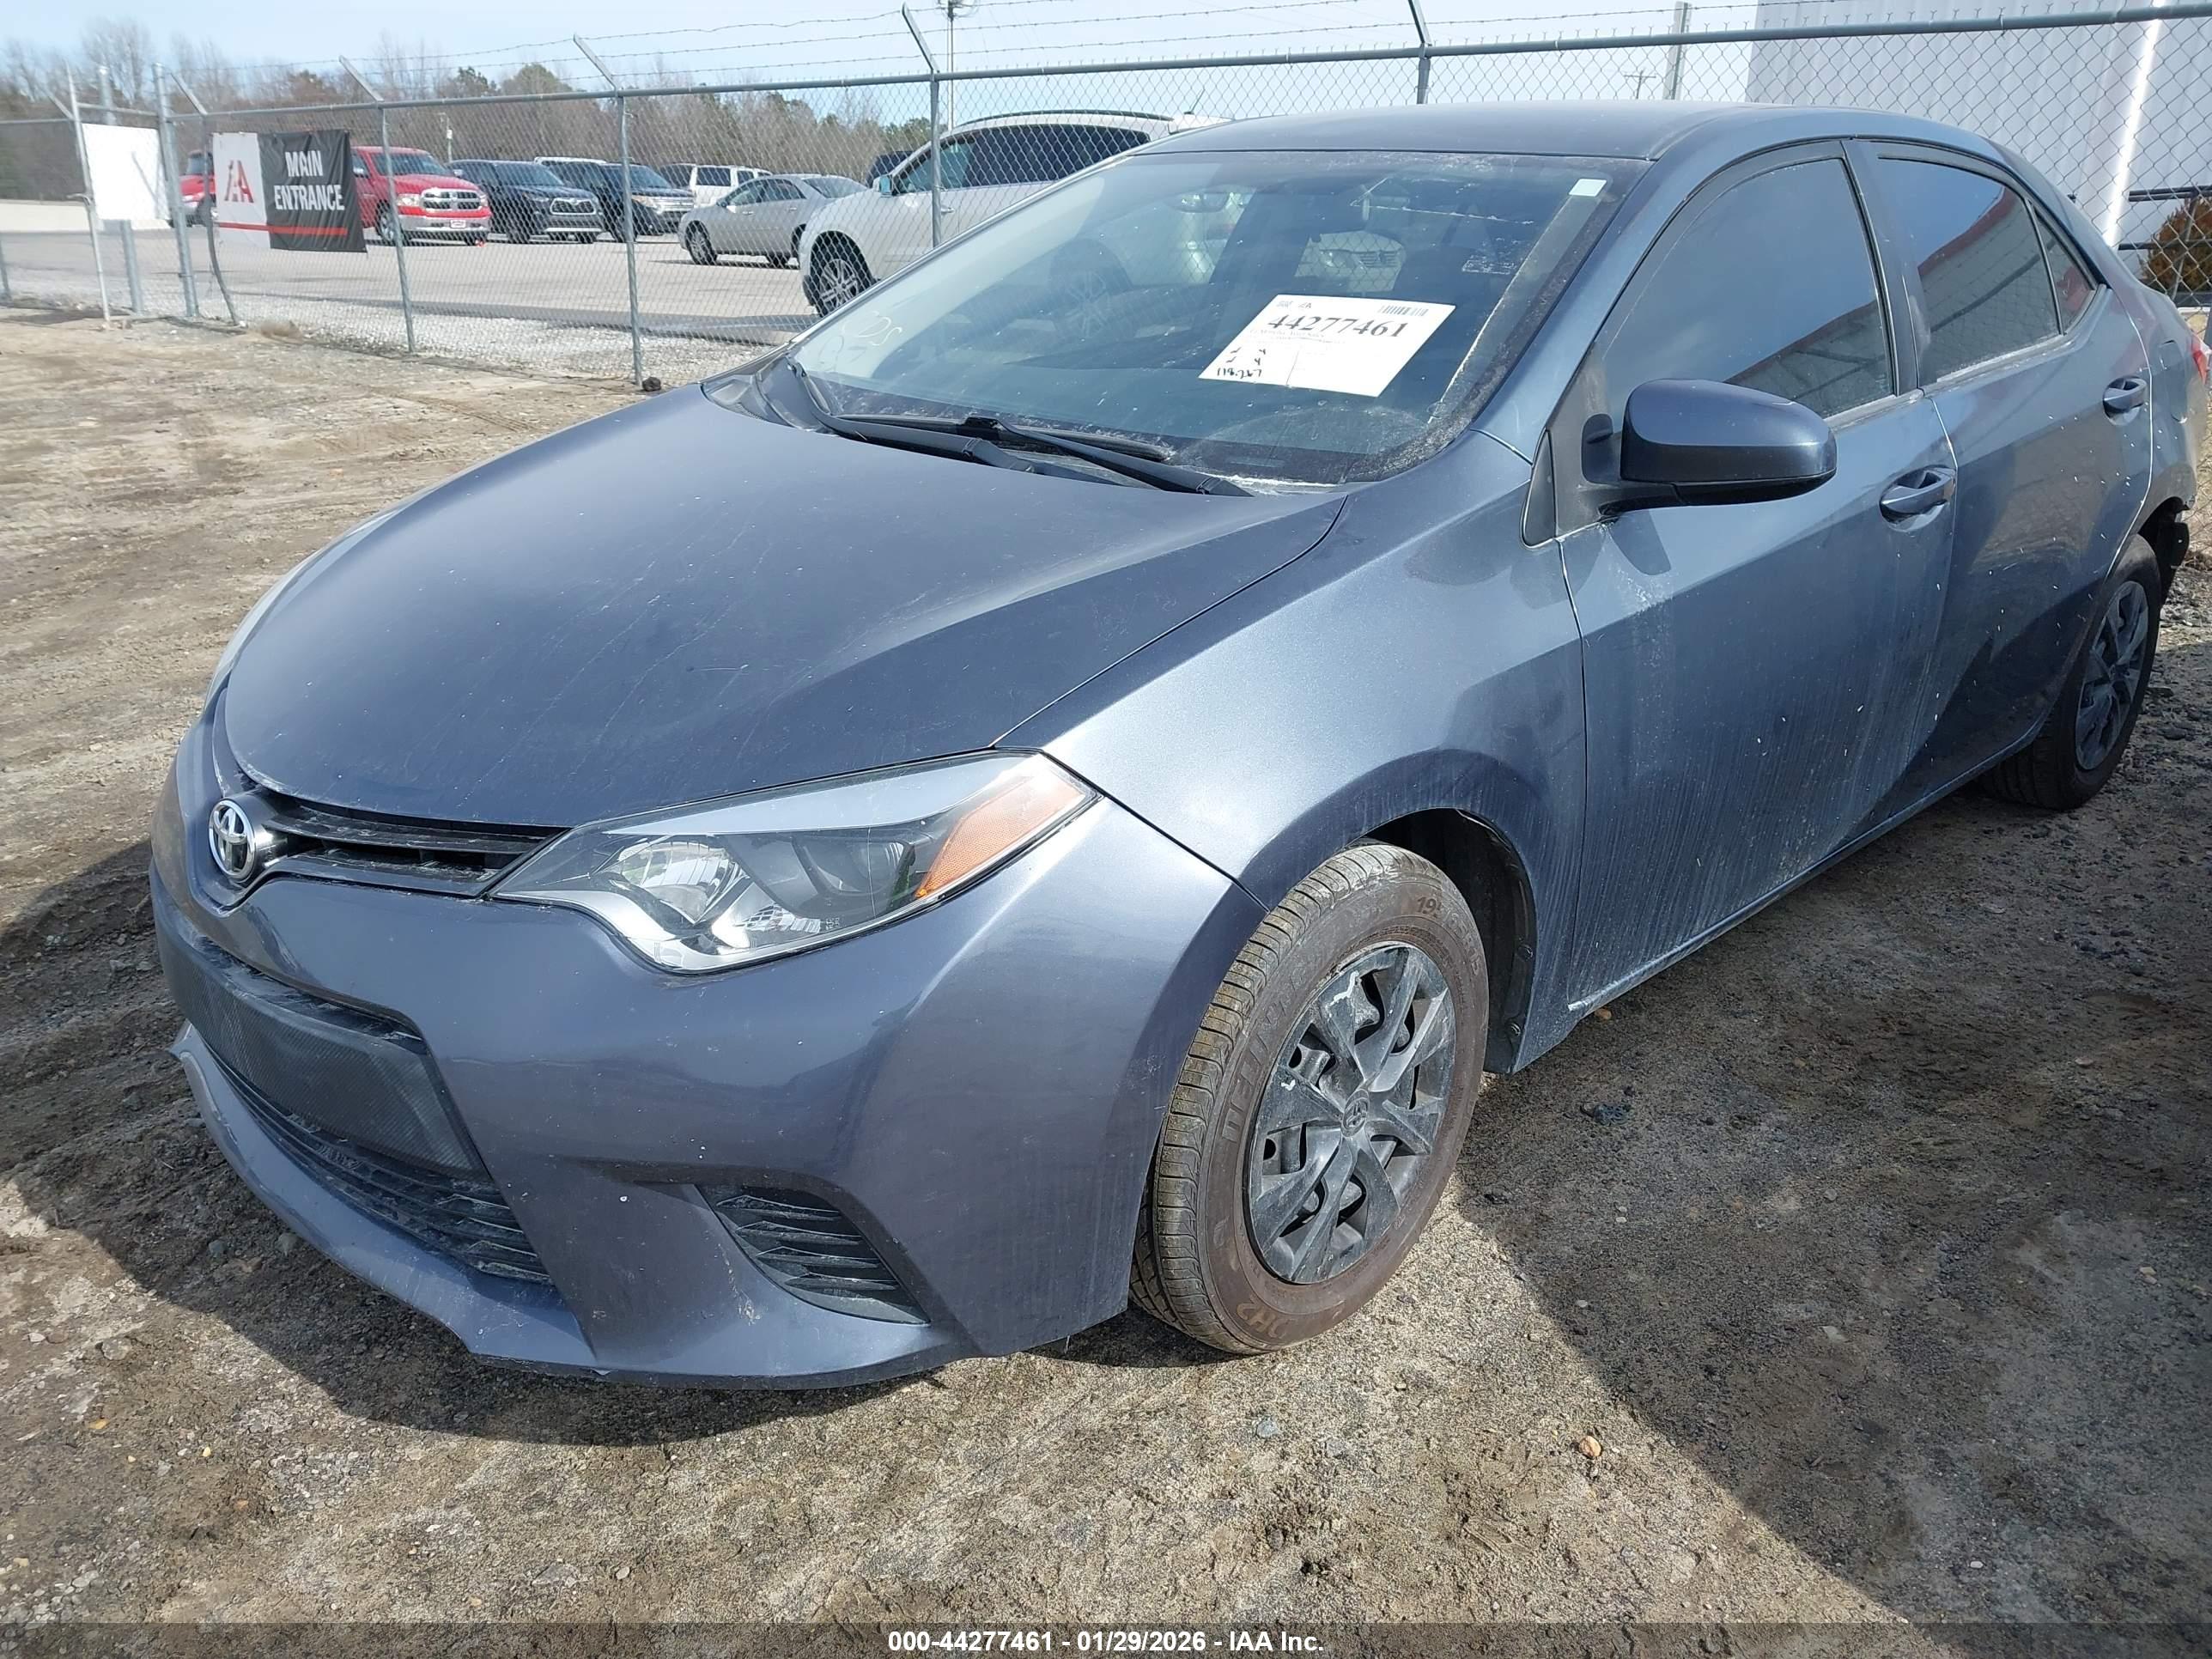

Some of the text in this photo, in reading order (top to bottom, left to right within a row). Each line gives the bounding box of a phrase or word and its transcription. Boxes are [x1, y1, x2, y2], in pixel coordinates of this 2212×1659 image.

[285, 150, 323, 177] MAIN
[274, 184, 345, 210] ENTRANCE
[1267, 313, 1408, 337] 44277461
